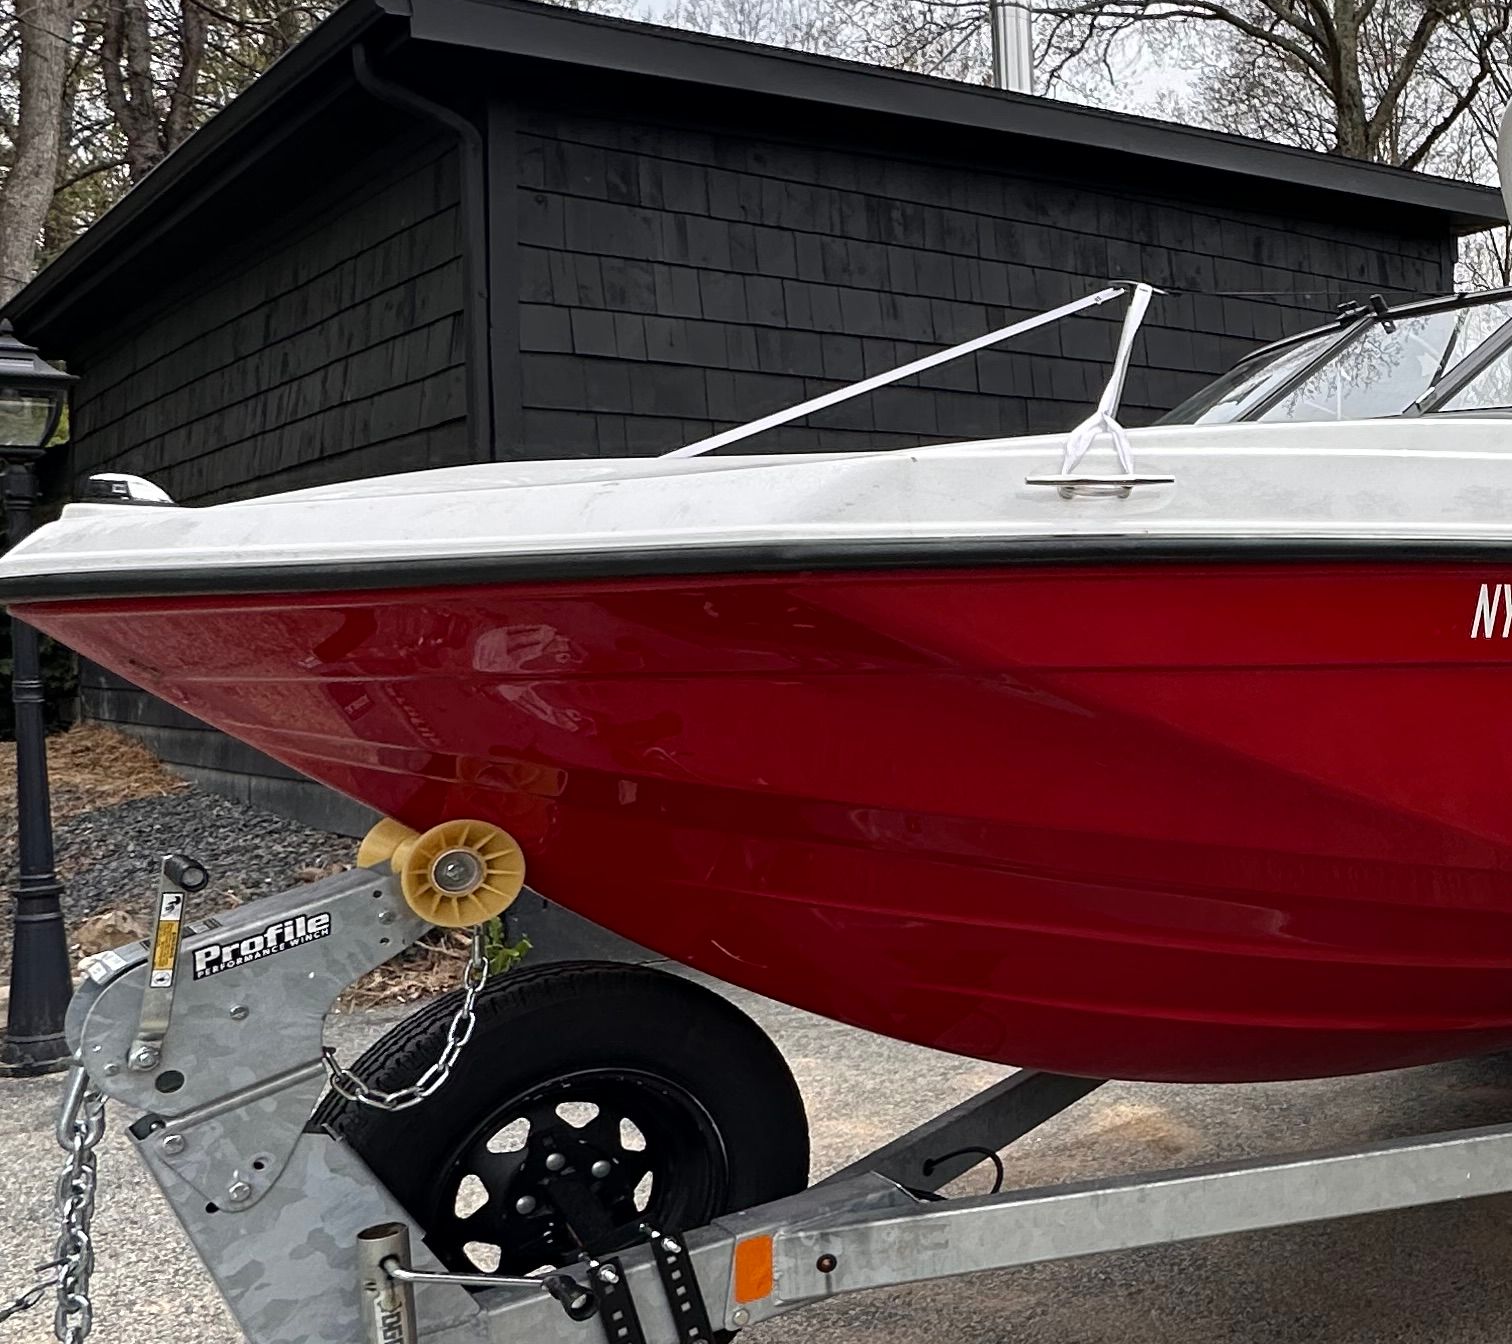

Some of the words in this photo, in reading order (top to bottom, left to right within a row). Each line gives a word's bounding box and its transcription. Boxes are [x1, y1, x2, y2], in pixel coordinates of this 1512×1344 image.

[194, 912, 331, 972] Profile
[197, 942, 285, 979] PERFORMANCE
[290, 927, 330, 947] WINCH
